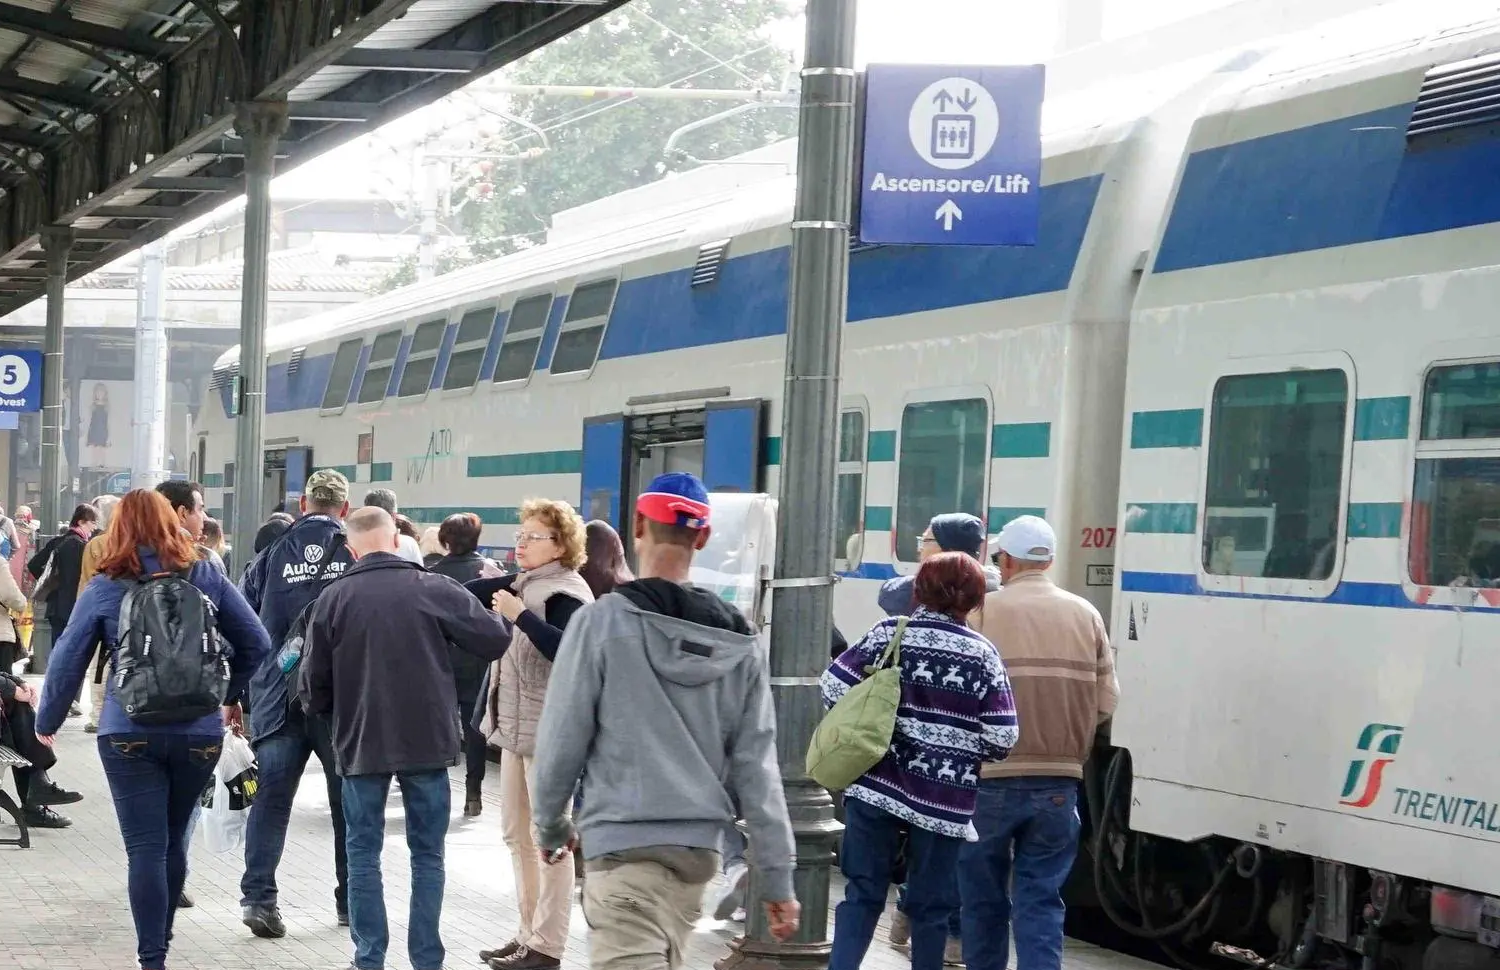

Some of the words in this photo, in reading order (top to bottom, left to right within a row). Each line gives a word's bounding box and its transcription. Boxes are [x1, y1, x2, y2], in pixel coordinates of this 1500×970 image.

[870, 172, 1031, 194] Ascensore/Lift
[3, 364, 18, 385] 5
[1393, 787, 1500, 834] TRENITAL
